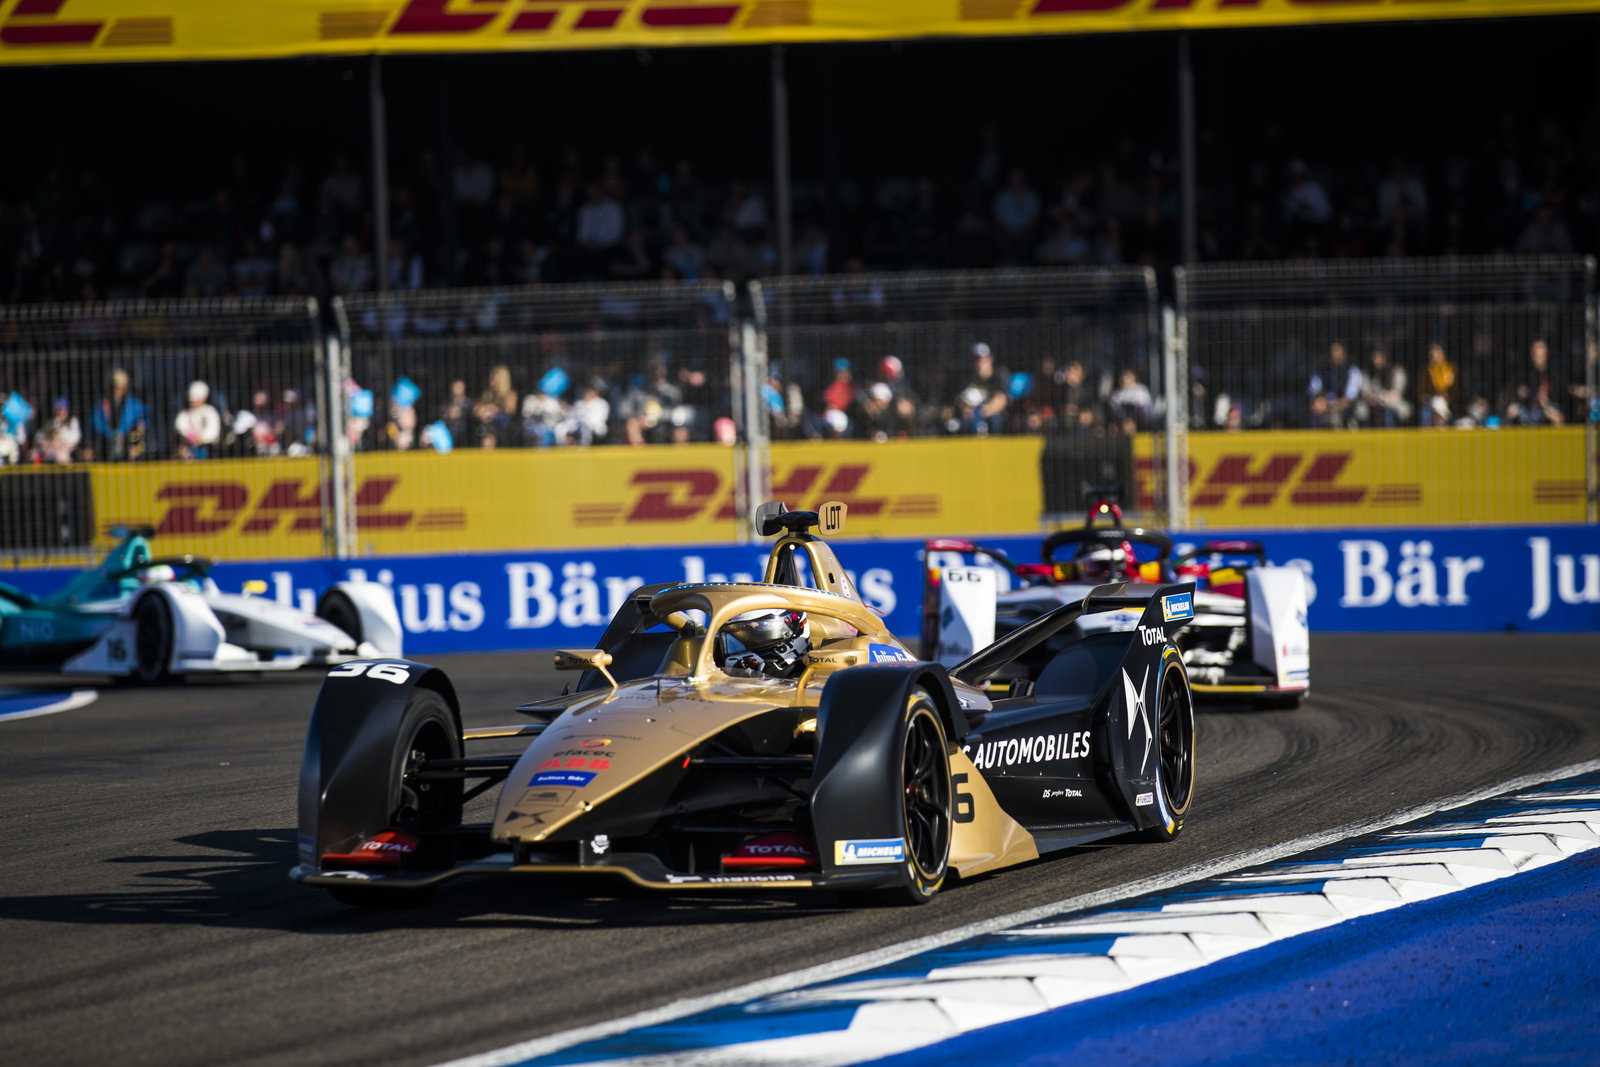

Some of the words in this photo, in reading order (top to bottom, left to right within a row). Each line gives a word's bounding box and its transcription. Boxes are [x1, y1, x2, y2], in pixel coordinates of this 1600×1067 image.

[626, 465, 887, 523] DHL
[156, 477, 414, 536] DHL
[825, 505, 842, 531] LOT
[1340, 540, 1484, 608] Bär
[506, 560, 646, 630] Bär
[1138, 625, 1167, 646] TOTAL
[568, 656, 596, 664] TOTAL
[808, 656, 838, 664] TOTAL
[327, 662, 410, 685] 36
[973, 730, 1092, 770] AUTOMOBILES
[535, 758, 611, 771] ABB
[1042, 789, 1051, 798] DS
[1065, 788, 1083, 797] TOTAL
[361, 840, 412, 852] TOTAL
[745, 845, 811, 855] TOTAL
[856, 845, 903, 857] MICHELIN
